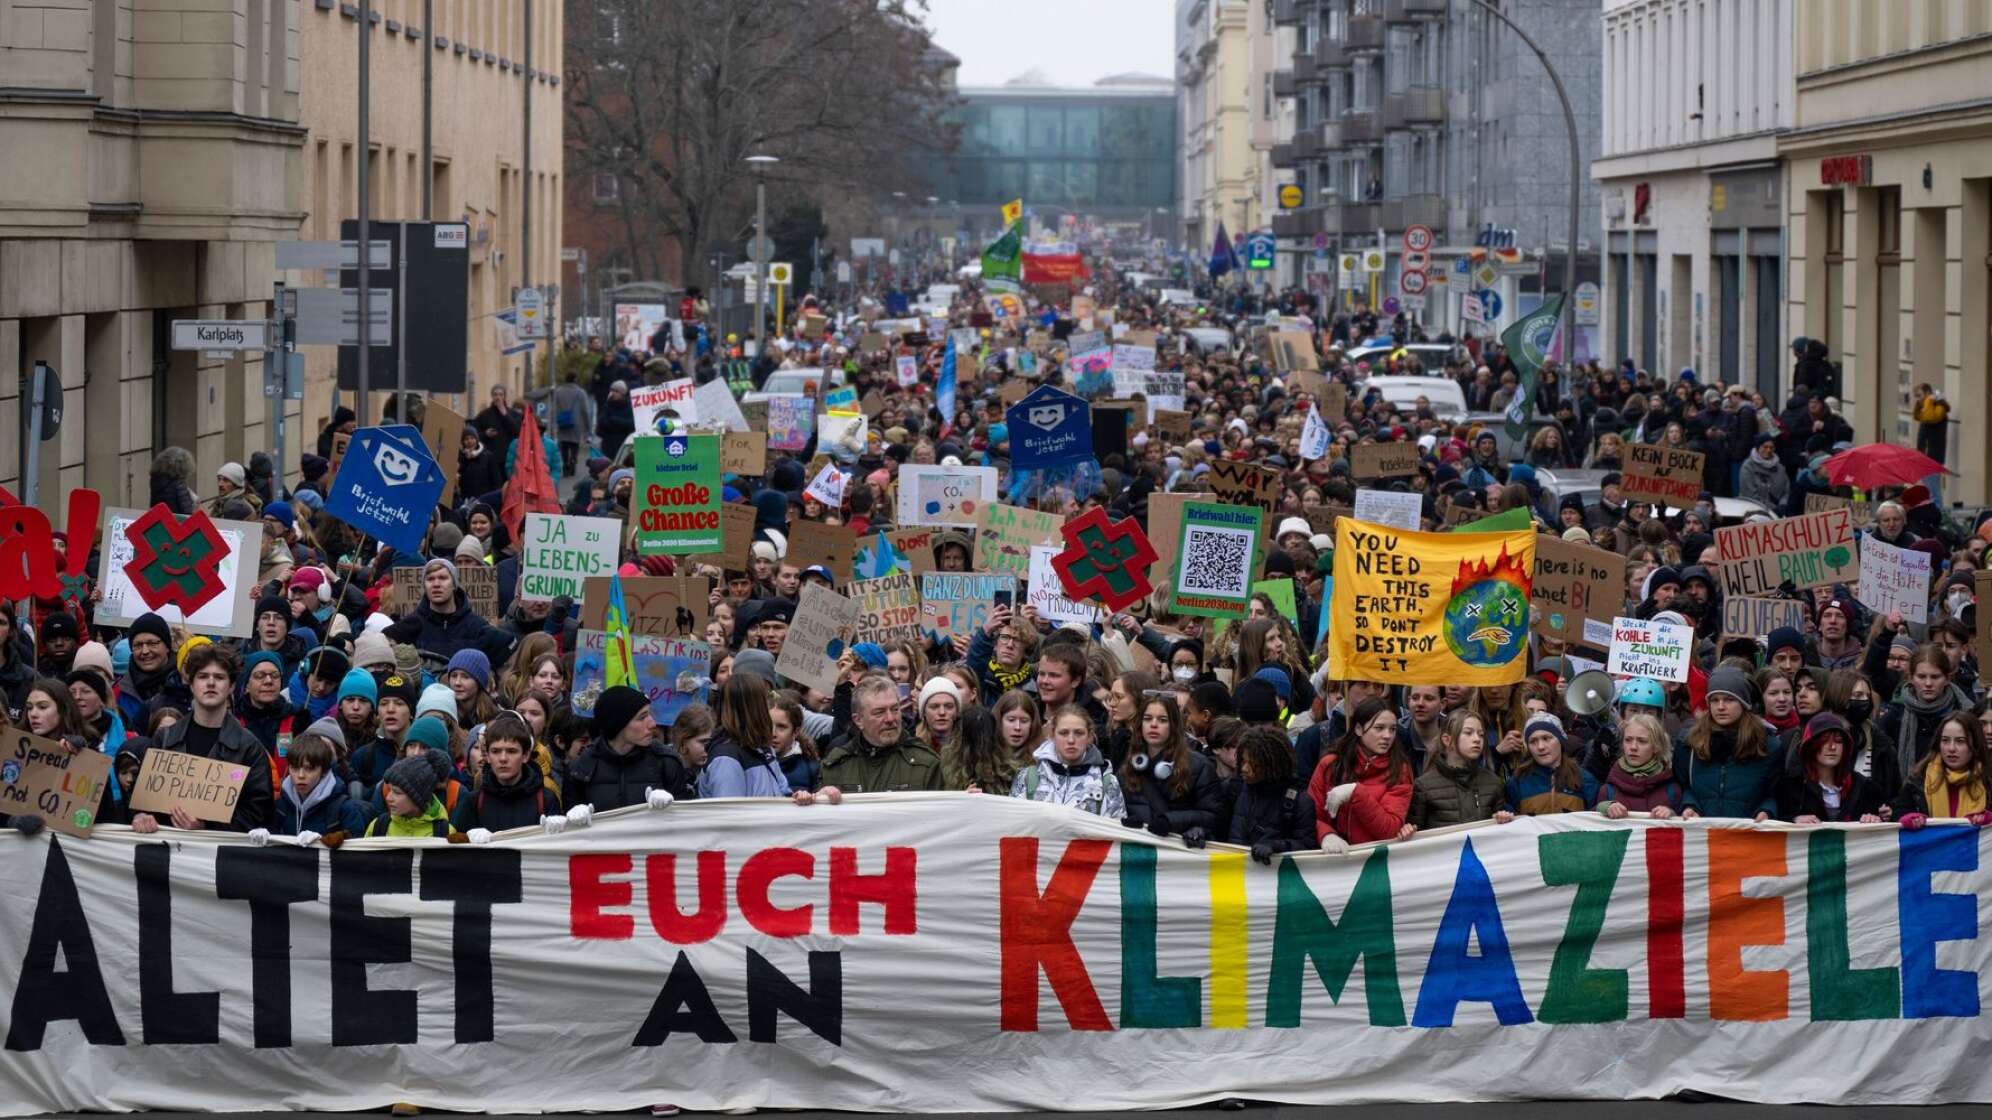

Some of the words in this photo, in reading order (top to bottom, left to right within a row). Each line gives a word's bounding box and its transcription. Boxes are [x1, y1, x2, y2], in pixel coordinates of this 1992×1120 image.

[1411, 231, 1425, 243] 30
[1477, 223, 1515, 247] dm
[197, 326, 244, 343] Karlplatz
[631, 383, 694, 408] ZUKUNFT
[1654, 466, 1672, 477] AUF
[1668, 451, 1700, 472] BOCK
[646, 482, 710, 507] Große
[639, 508, 720, 532] Chance
[1187, 508, 1234, 523] Briefwahl
[536, 518, 567, 544] JA
[1349, 530, 1398, 551] YOU
[1718, 510, 1853, 561] KLIMASCHUTZ
[525, 549, 612, 574] LEBENS-
[1356, 552, 1420, 576] NEED
[1533, 557, 1569, 576] here
[1572, 558, 1585, 576] is
[1590, 567, 1607, 581] no
[1724, 559, 1775, 596] WEIL
[1778, 551, 1825, 587] BAUM
[882, 574, 911, 592] OUR
[1876, 567, 1889, 581] die
[922, 575, 962, 600] GANZ
[1382, 579, 1430, 598] THIS
[1030, 589, 1047, 603] NO
[1047, 593, 1101, 616] PROBLEM
[1355, 595, 1423, 615] EARTH,
[858, 614, 879, 630] SO
[882, 606, 917, 627] STOP
[951, 602, 988, 633] EIS
[1355, 615, 1369, 629] SO
[1724, 598, 1748, 635] GO
[1752, 600, 1802, 635] VEGAN
[1615, 629, 1651, 644] KOHLE
[1658, 625, 1672, 634] die
[1355, 634, 1438, 654] DESTROY
[1630, 643, 1684, 660] ZUKUNFT
[1379, 658, 1408, 672] IT
[1621, 661, 1678, 679] KRAFTWERK
[15, 736, 72, 770] Spread
[151, 751, 196, 777] THERE
[204, 763, 224, 783] IS
[3, 784, 29, 802] not
[61, 772, 102, 801] LOVE
[145, 775, 165, 793] NO
[168, 778, 225, 803] PLANET
[224, 786, 238, 807] B
[568, 846, 918, 945] EUCH
[999, 825, 1981, 1032] KLIMAZIELE
[633, 945, 843, 1047] AN
